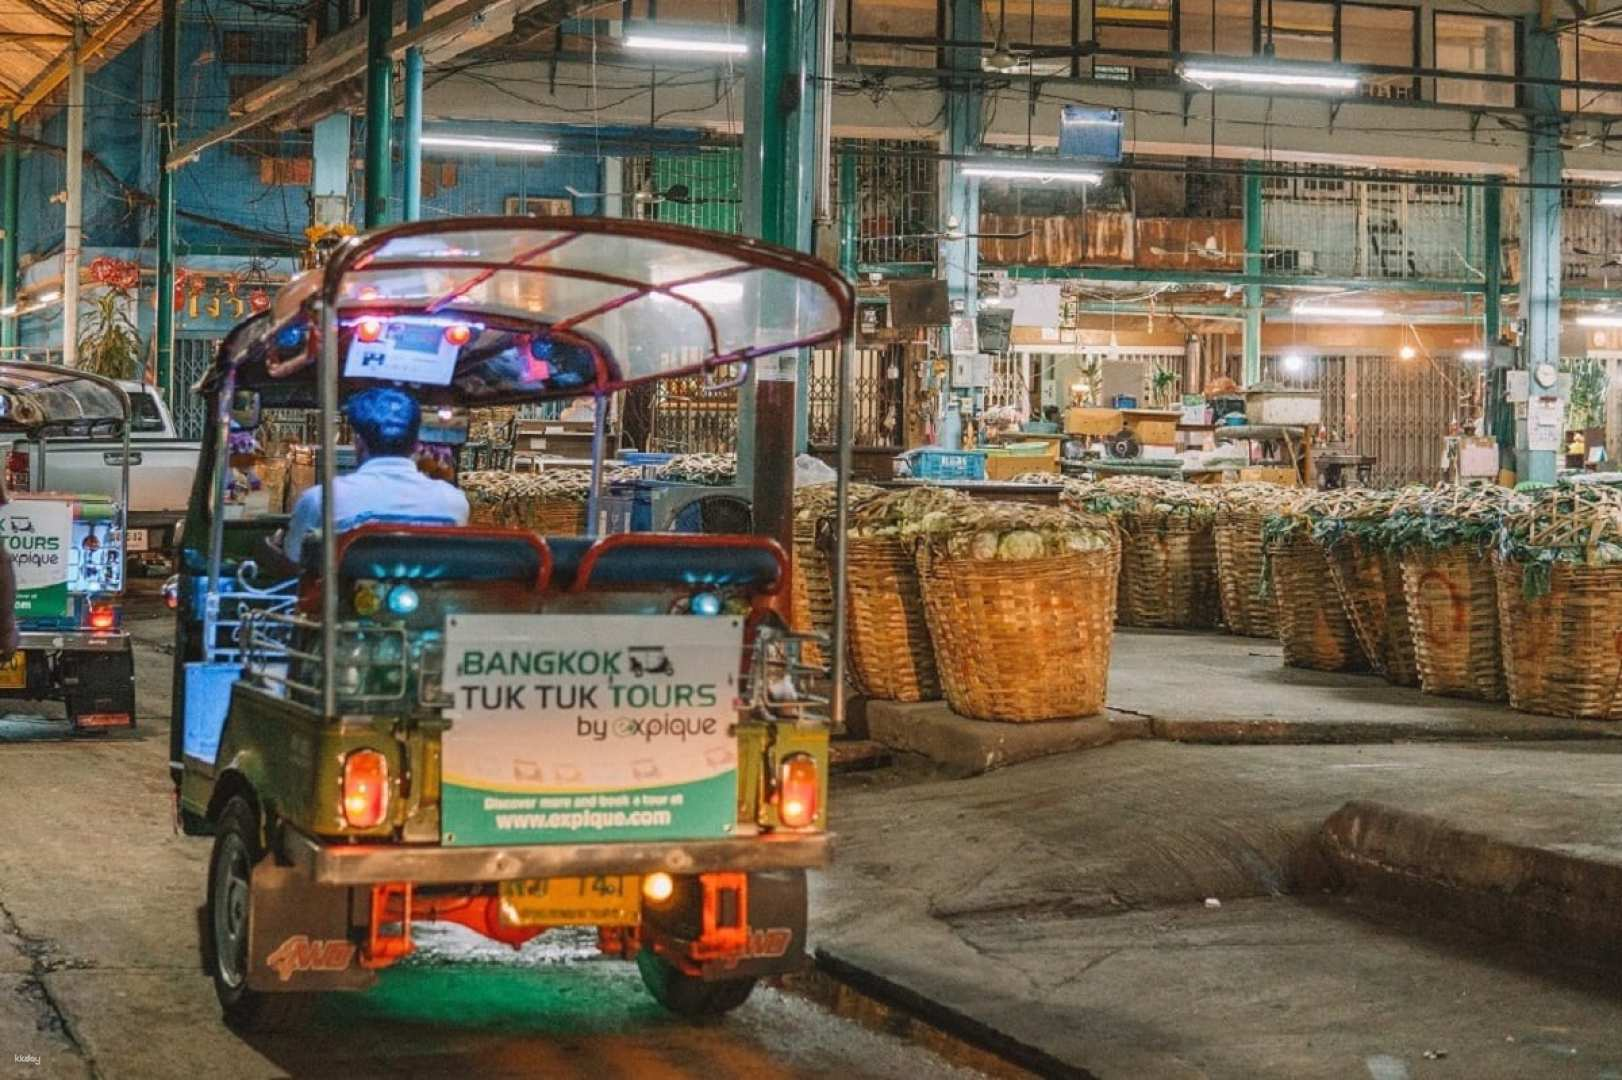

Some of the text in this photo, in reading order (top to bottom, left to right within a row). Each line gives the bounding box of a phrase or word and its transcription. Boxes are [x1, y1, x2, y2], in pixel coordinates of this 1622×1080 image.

[464, 651, 621, 675] BANGKOK
[460, 684, 717, 709] TUK TUK TOURS
[577, 713, 717, 742] by expique
[574, 795, 596, 808] and
[496, 809, 672, 830] www.expique.com
[267, 934, 357, 981] 4WD
[736, 927, 792, 963] WD
